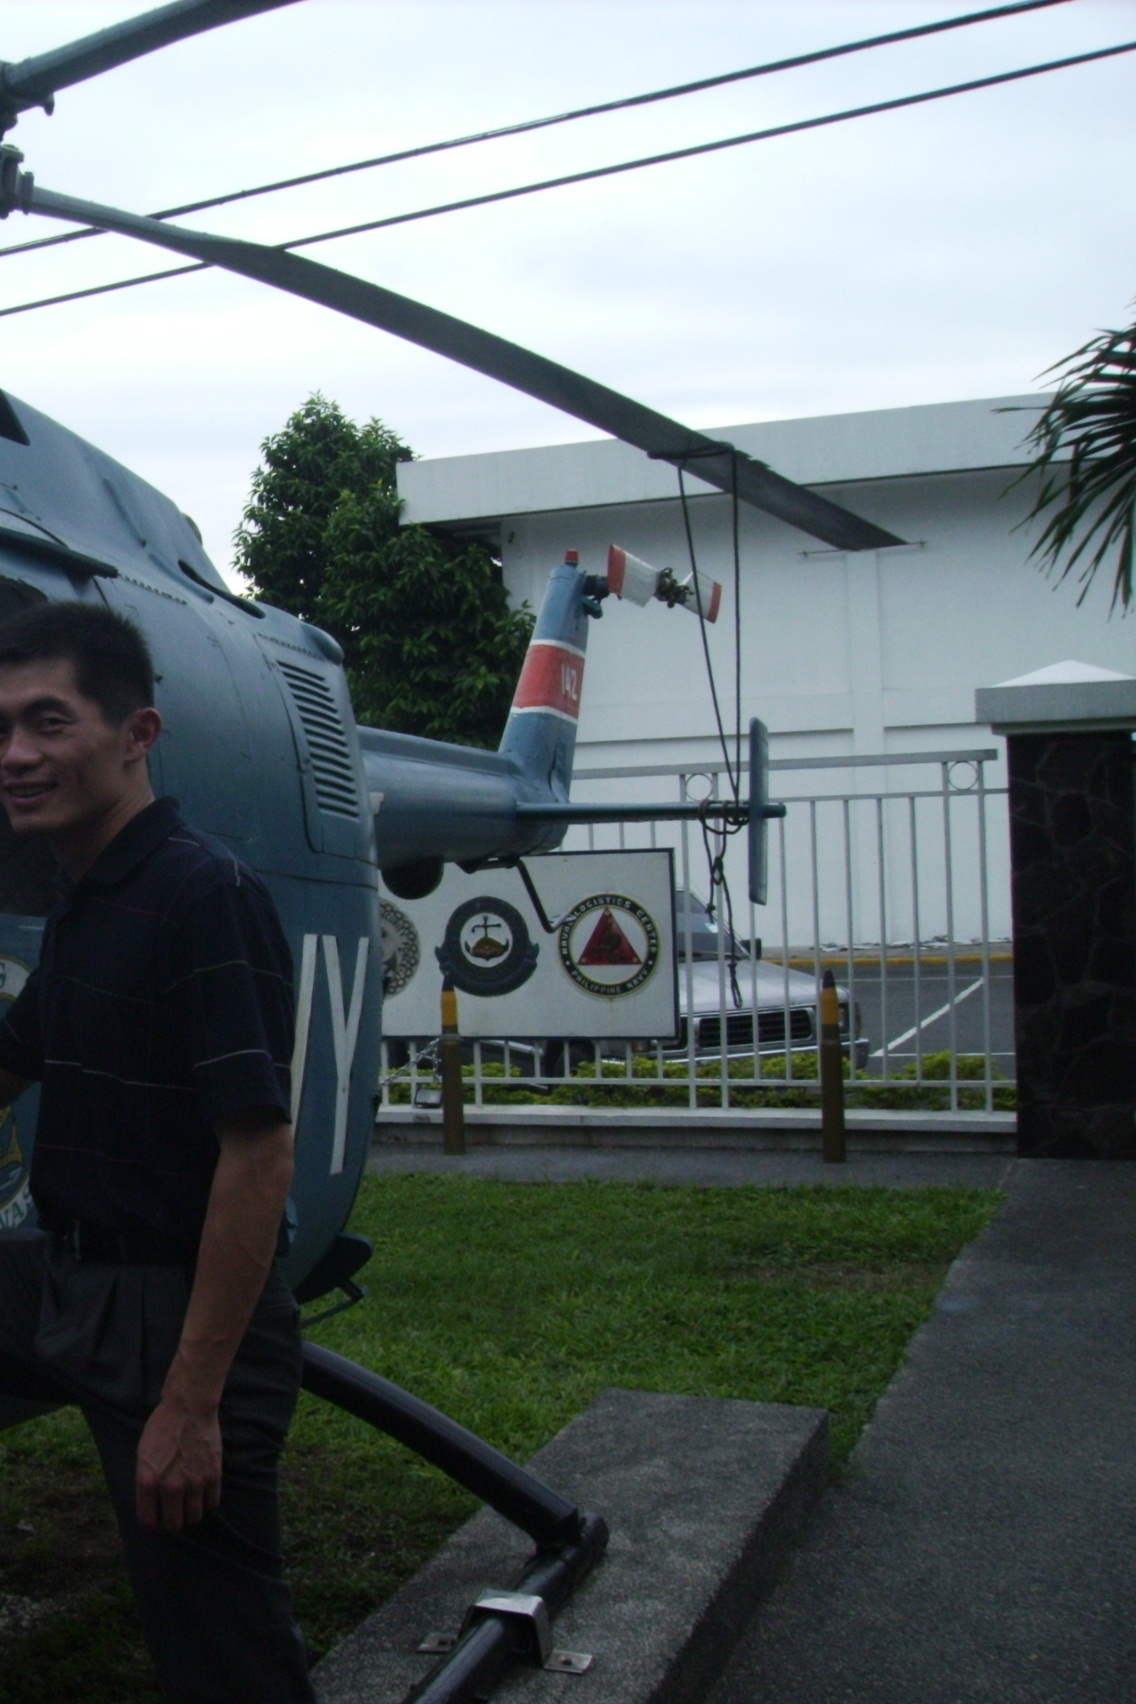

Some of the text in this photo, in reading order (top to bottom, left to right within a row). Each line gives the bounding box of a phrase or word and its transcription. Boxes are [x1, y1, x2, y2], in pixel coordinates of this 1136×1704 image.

[575, 897, 631, 916] LOGISTICS
[636, 909, 658, 953] CENTER
[571, 968, 649, 994] PHILIPPINE NAVY
